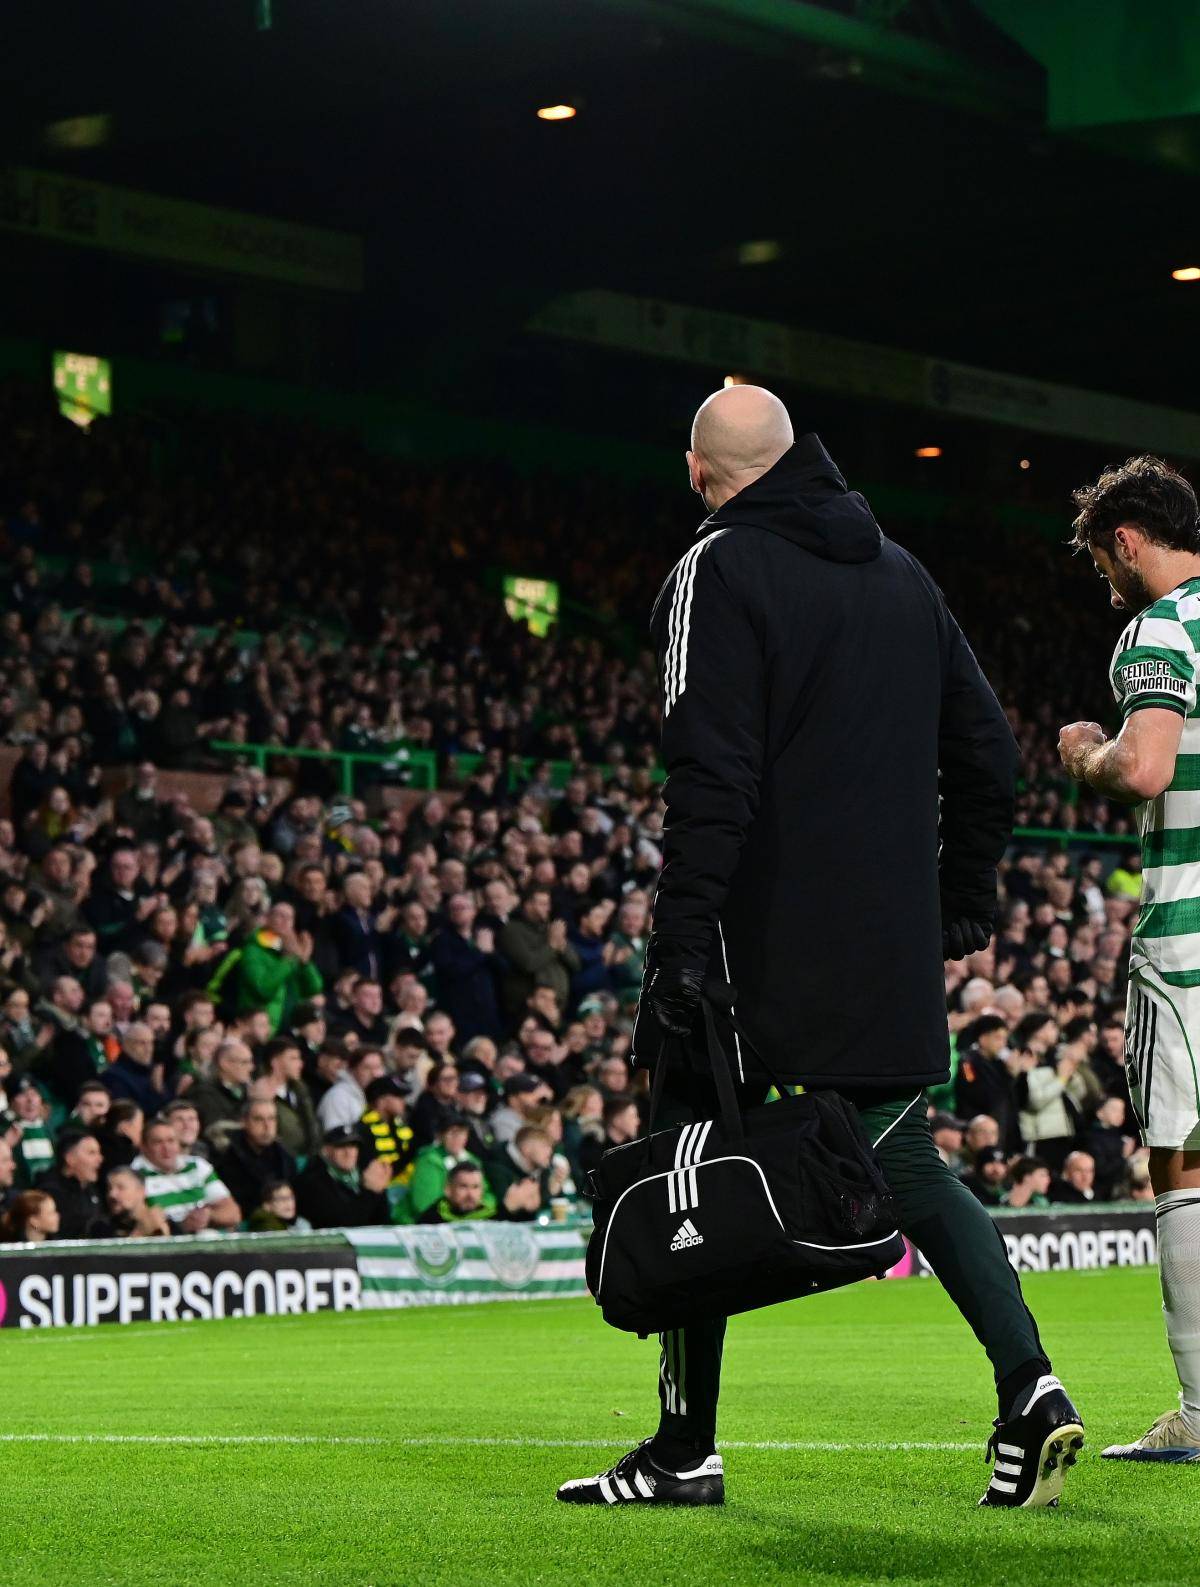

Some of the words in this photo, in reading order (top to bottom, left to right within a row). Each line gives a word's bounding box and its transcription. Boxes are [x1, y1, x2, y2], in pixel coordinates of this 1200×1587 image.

[1121, 661, 1154, 682] CELTIC
[1156, 661, 1171, 676] FC
[670, 1235, 704, 1251] adidas
